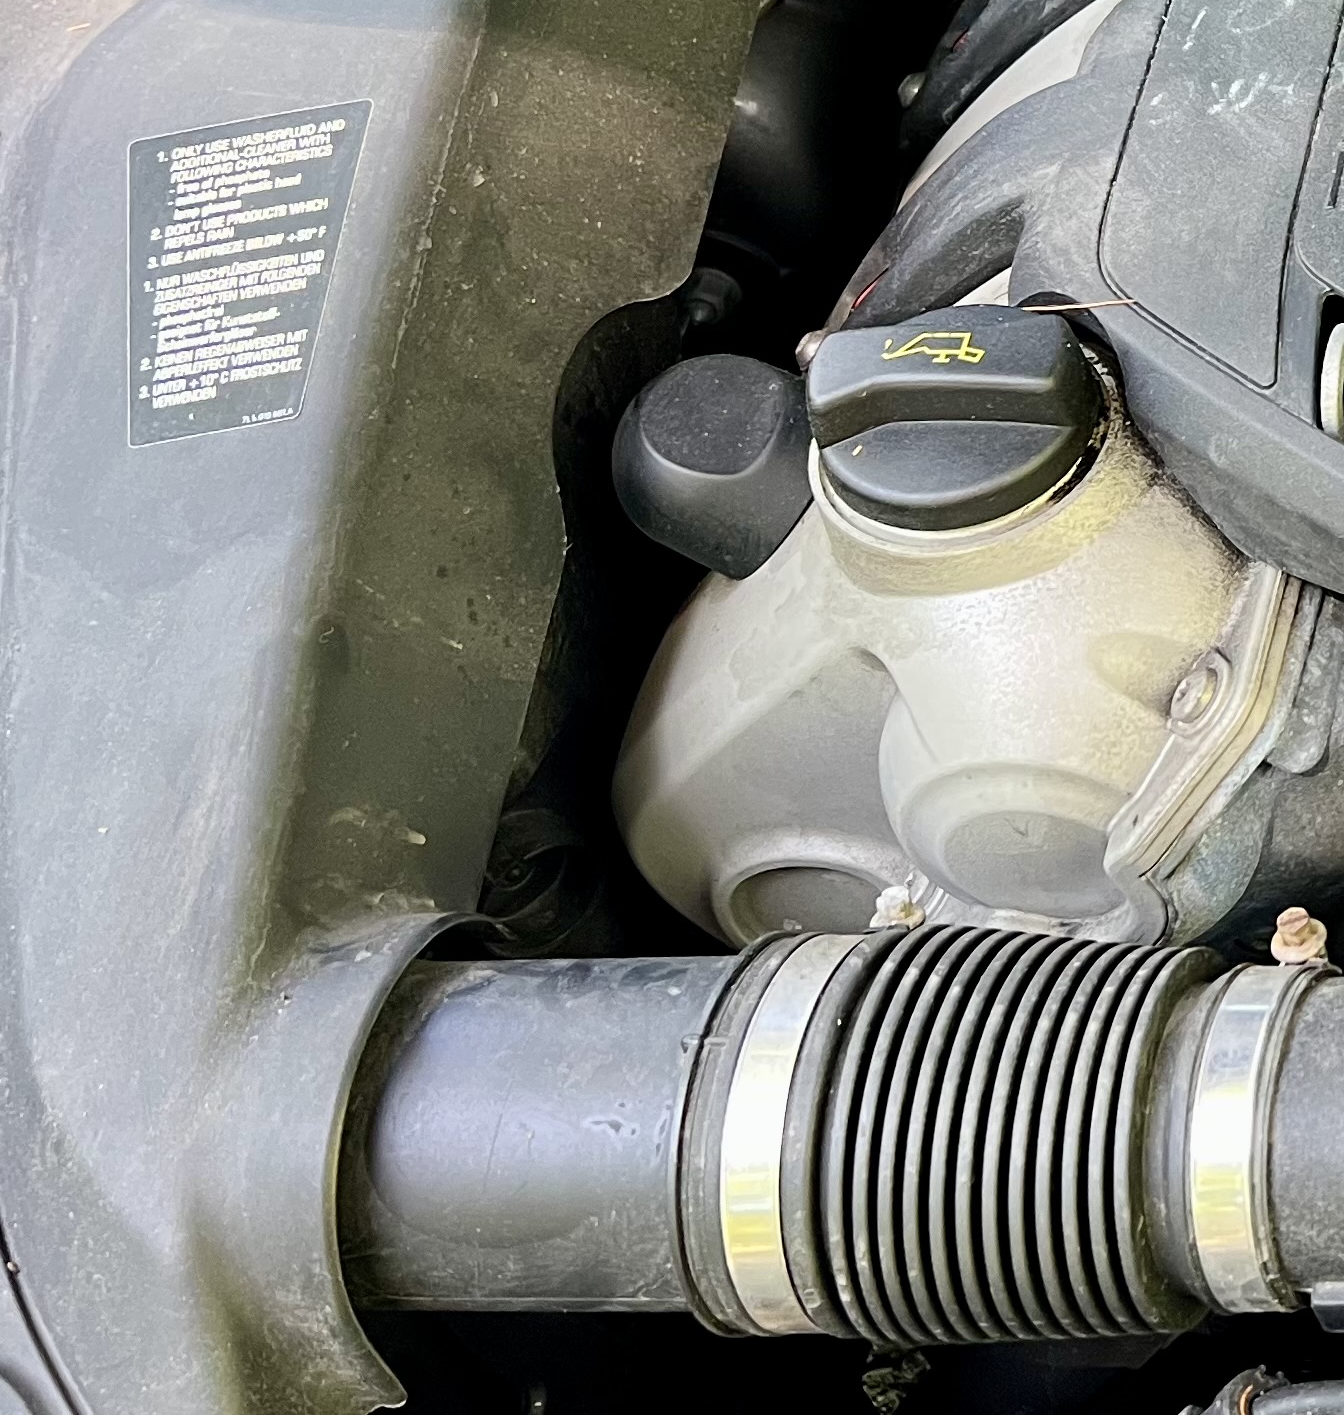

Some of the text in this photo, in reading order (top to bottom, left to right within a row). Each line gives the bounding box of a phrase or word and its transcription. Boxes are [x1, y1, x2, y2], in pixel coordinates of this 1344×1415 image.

[171, 144, 204, 159] ONLY
[205, 139, 230, 153] USE
[232, 124, 316, 147] WASHERFLUID
[317, 119, 345, 133] AND
[299, 133, 330, 147] WITH
[170, 144, 332, 183] FOLLOWING CHARACTERISTICS
[202, 215, 225, 230] USE
[226, 205, 287, 225] PRODUCTS
[289, 198, 328, 214] WHICH
[164, 226, 234, 249] REPELS RAIN
[161, 251, 183, 266] USE
[184, 240, 244, 261] ANTIFREEZE
[156, 275, 180, 289] NUR
[300, 249, 324, 263] UND
[239, 273, 260, 286] MIT
[260, 263, 320, 283] FOLGENDEN
[240, 277, 306, 299] VERWENDEN
[154, 350, 193, 367] KEINEN
[286, 329, 308, 343] MIT
[231, 344, 298, 366] VERWENDEN
[152, 379, 186, 396] UNTER
[219, 371, 229, 384] C
[230, 358, 302, 381] FROSTSCHUTZ
[152, 386, 216, 408] VERWENDEN
